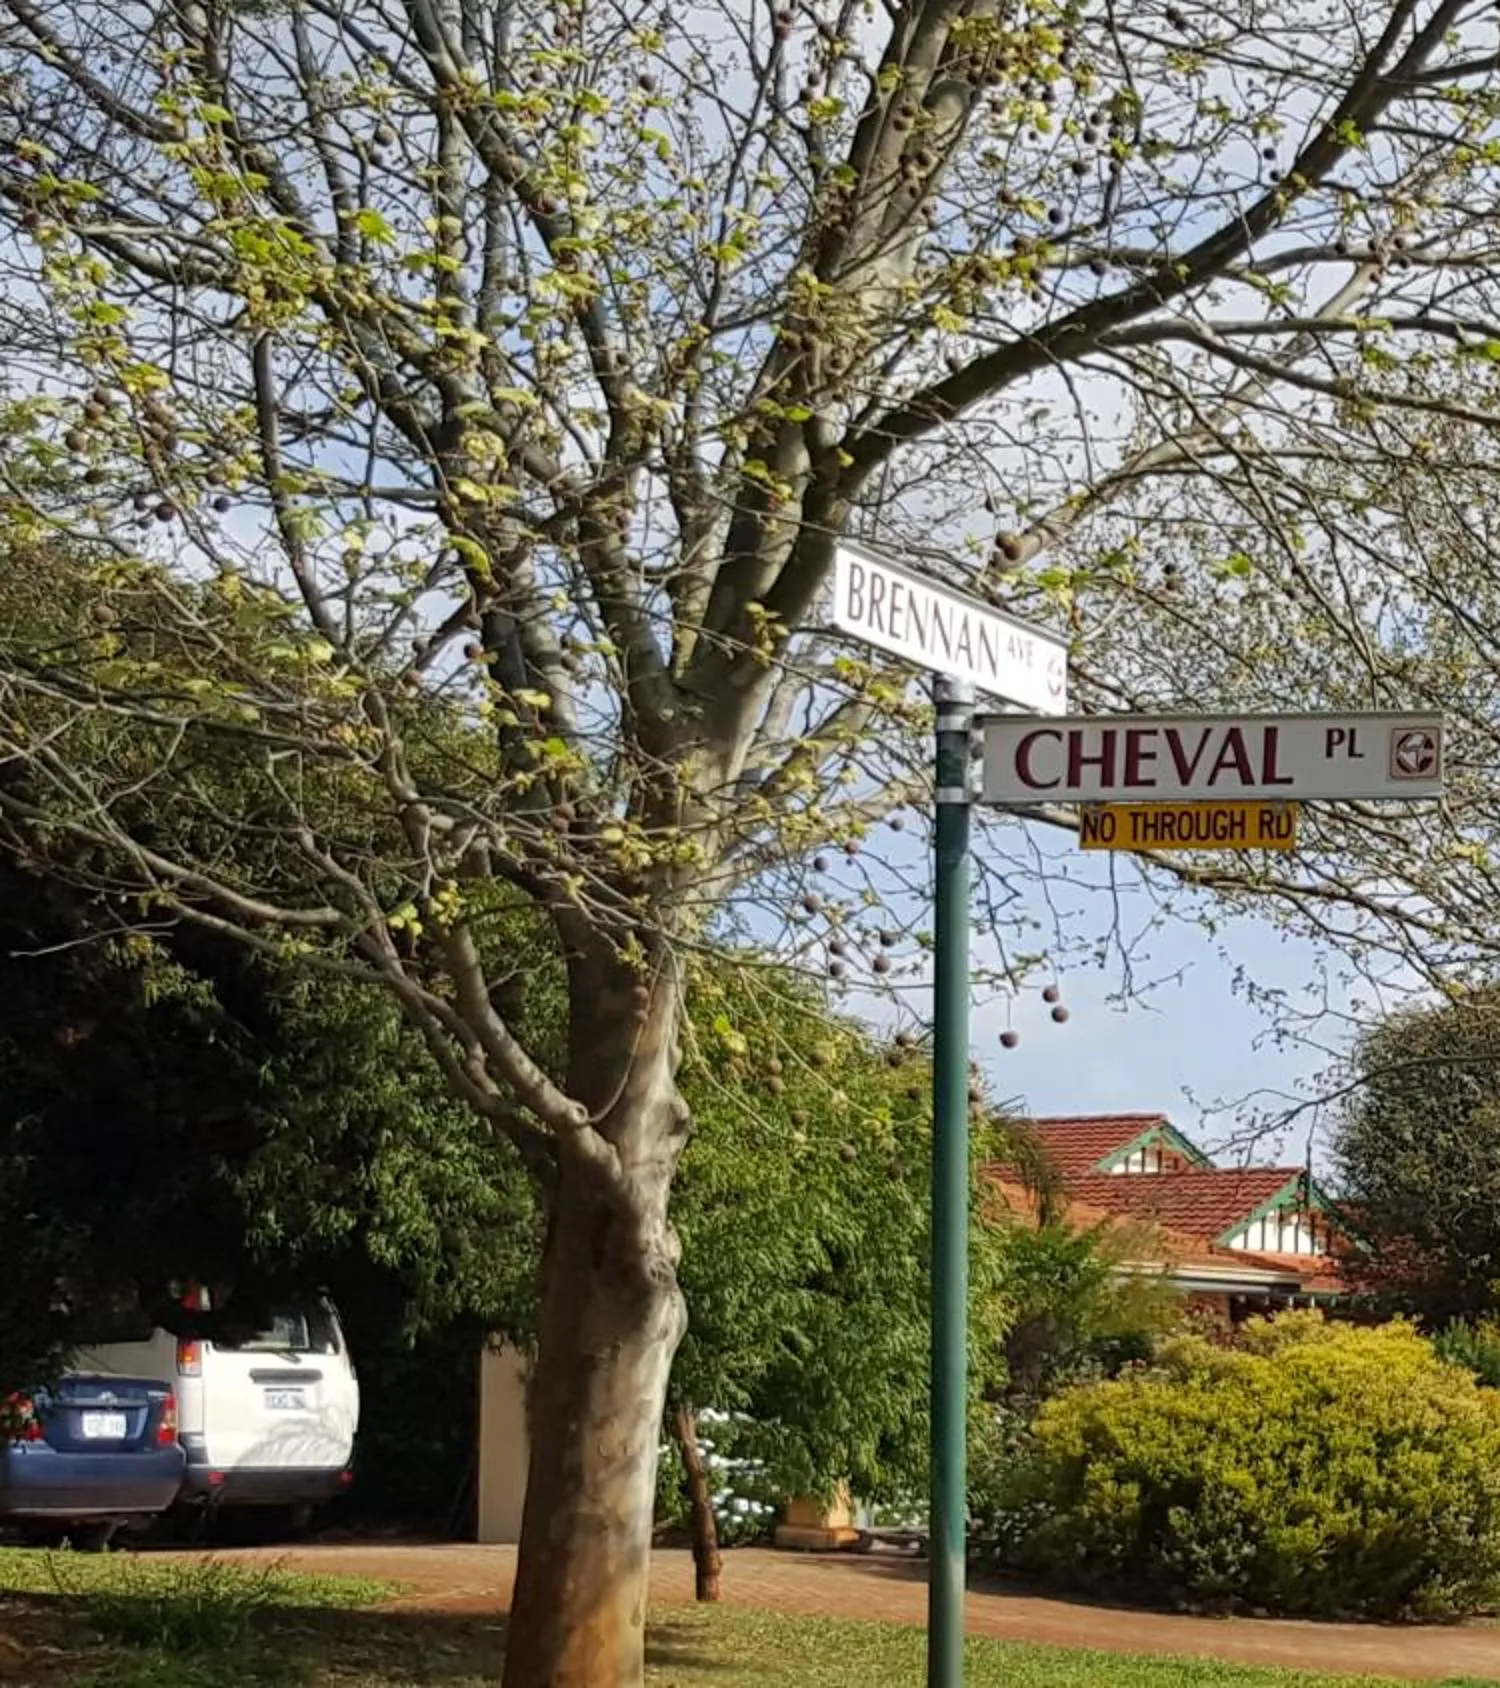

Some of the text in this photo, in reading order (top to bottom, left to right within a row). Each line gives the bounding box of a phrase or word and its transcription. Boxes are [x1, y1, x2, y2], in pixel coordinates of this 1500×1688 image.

[849, 563, 1034, 680] BRENNAN AVE
[1015, 726, 1364, 789] CHEVAL PL
[1081, 807, 1293, 843] NO THROUGH RD
